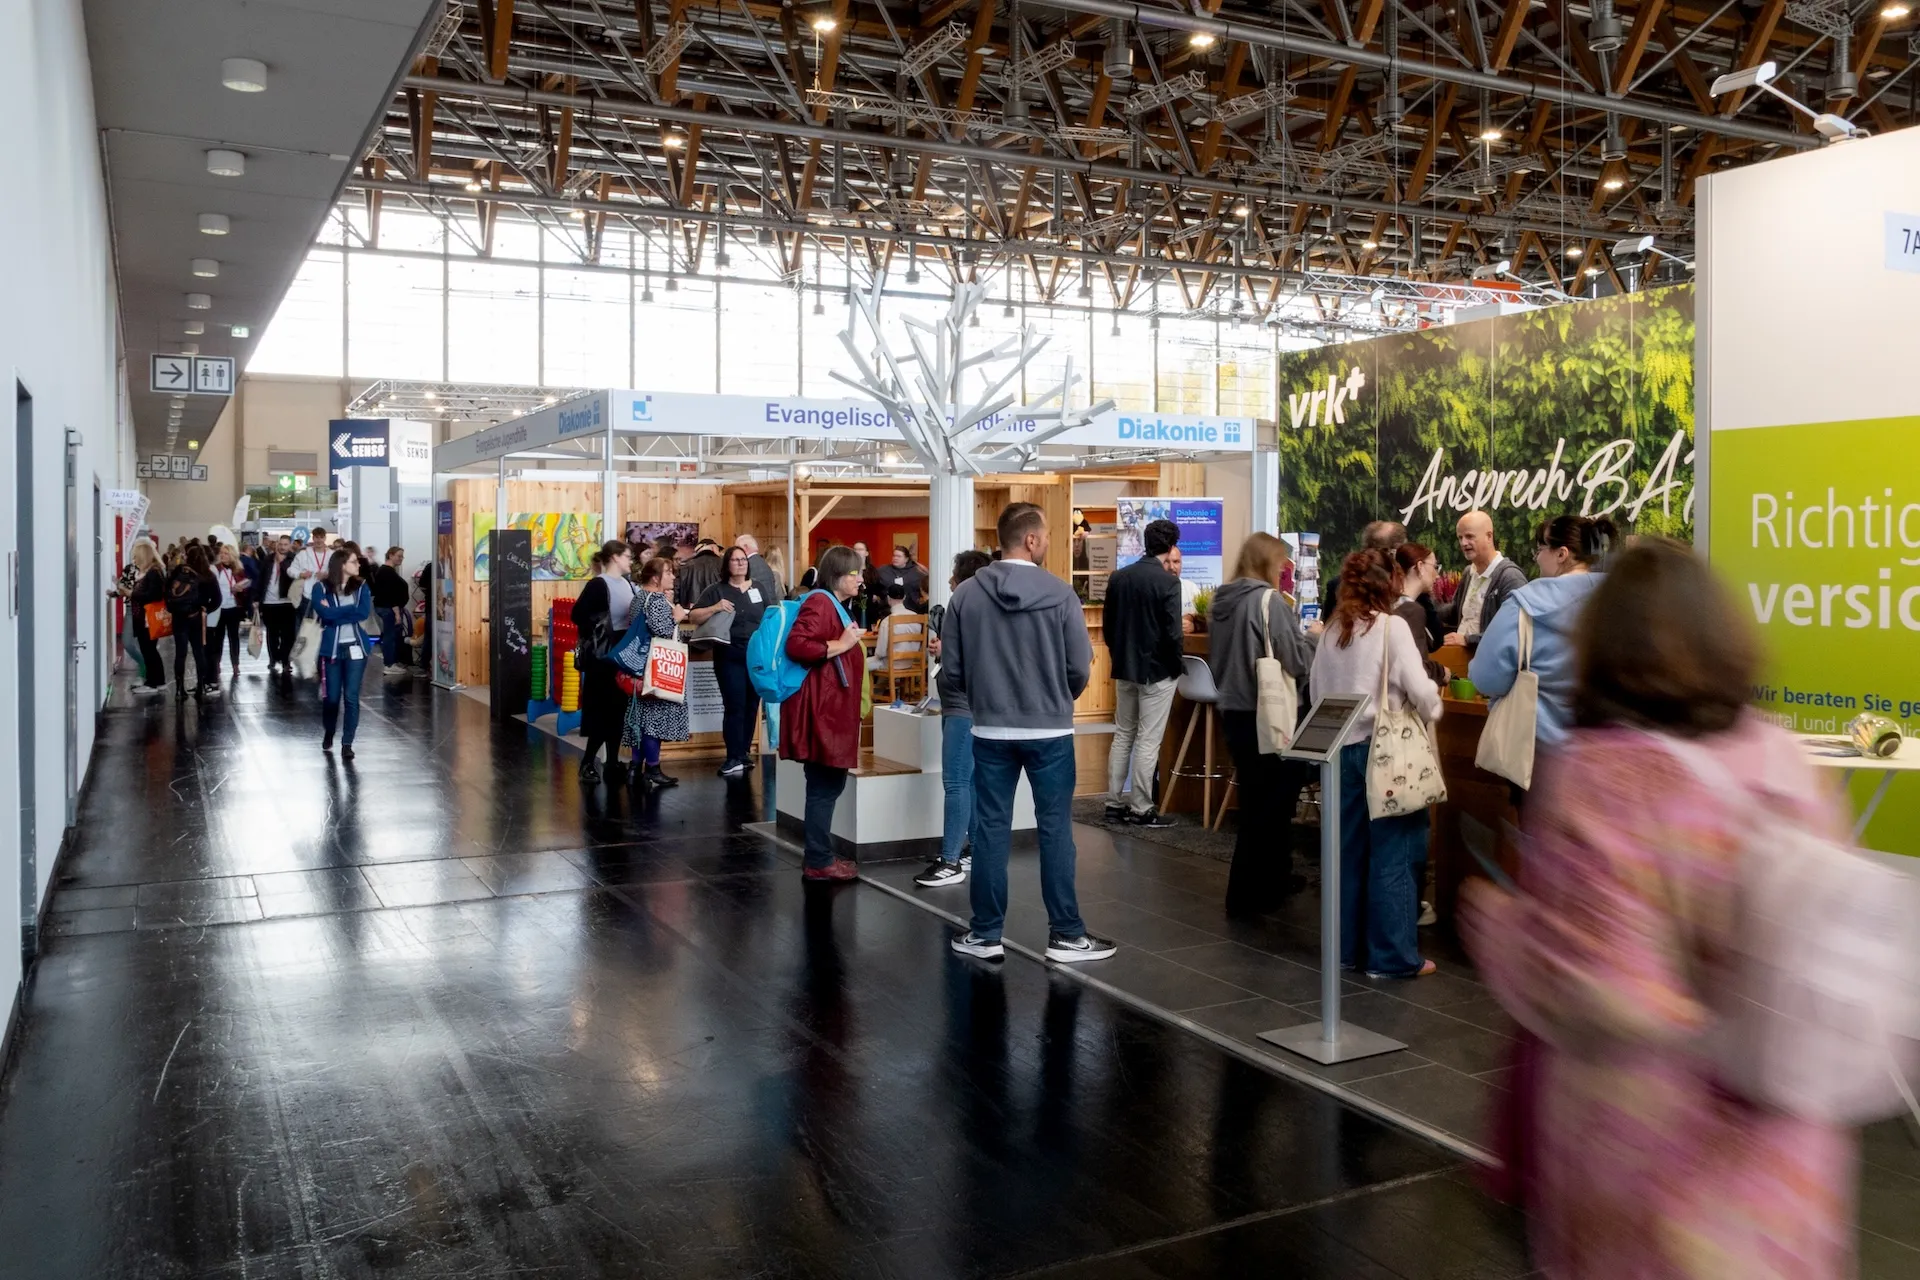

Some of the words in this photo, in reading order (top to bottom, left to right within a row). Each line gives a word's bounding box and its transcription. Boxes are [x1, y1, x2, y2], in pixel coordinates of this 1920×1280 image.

[558, 403, 592, 435] Diakonie
[1118, 417, 1218, 442] Diakonie
[351, 444, 385, 458] SENSO
[406, 447, 429, 460] SENSO
[1176, 509, 1209, 517] Diakonie
[652, 647, 683, 664] BASSD
[657, 659, 684, 680] SCHO!
[1783, 686, 1857, 709] beraten
[1863, 694, 1893, 712] Sie
[1803, 716, 1836, 733] und
